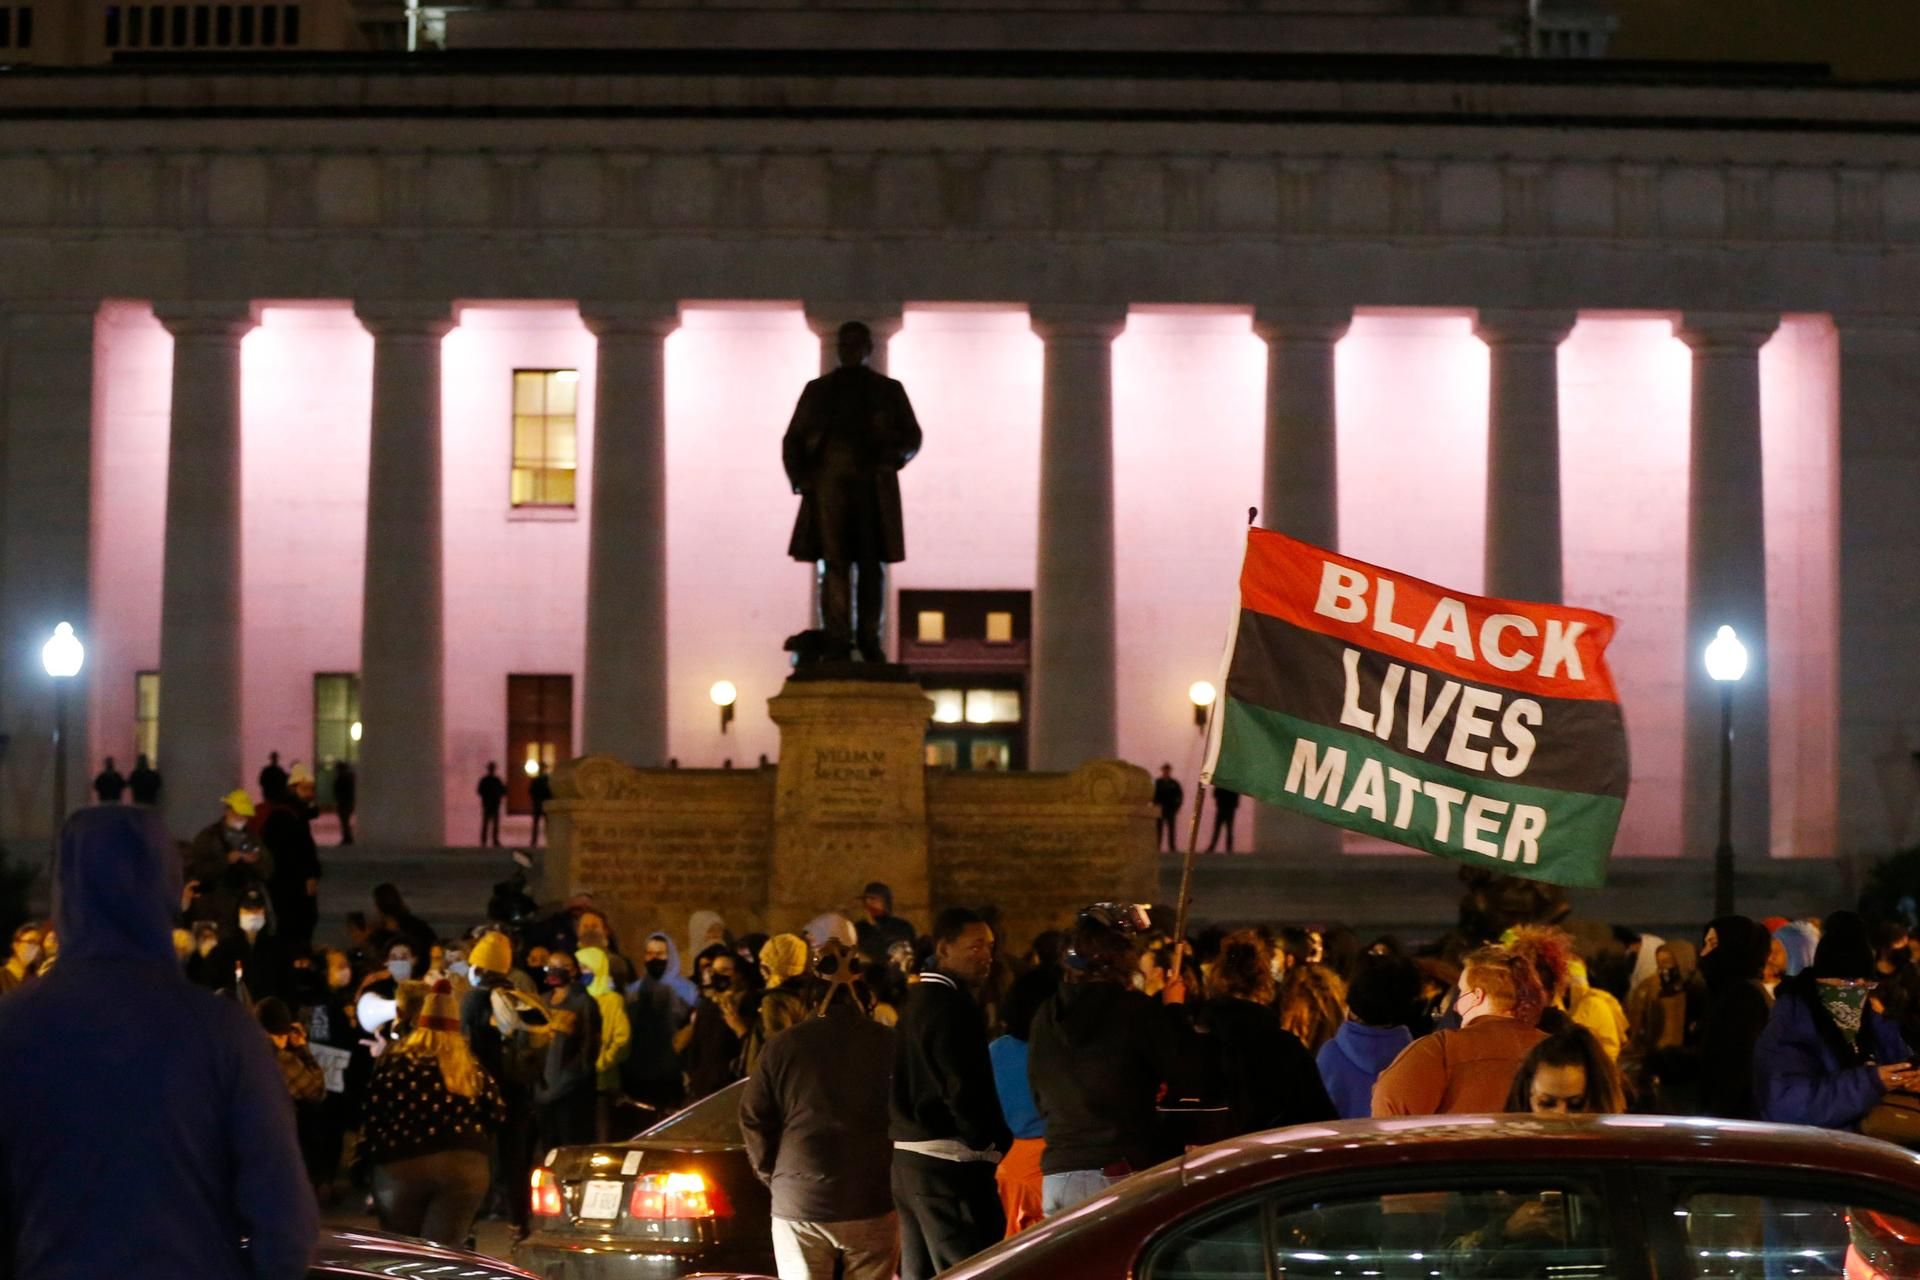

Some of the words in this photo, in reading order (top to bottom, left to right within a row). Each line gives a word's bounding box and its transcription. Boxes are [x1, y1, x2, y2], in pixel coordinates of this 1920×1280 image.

[1313, 560, 1588, 681] BLACK
[1339, 647, 1544, 778] LIVES
[1284, 737, 1547, 865] MATTER
